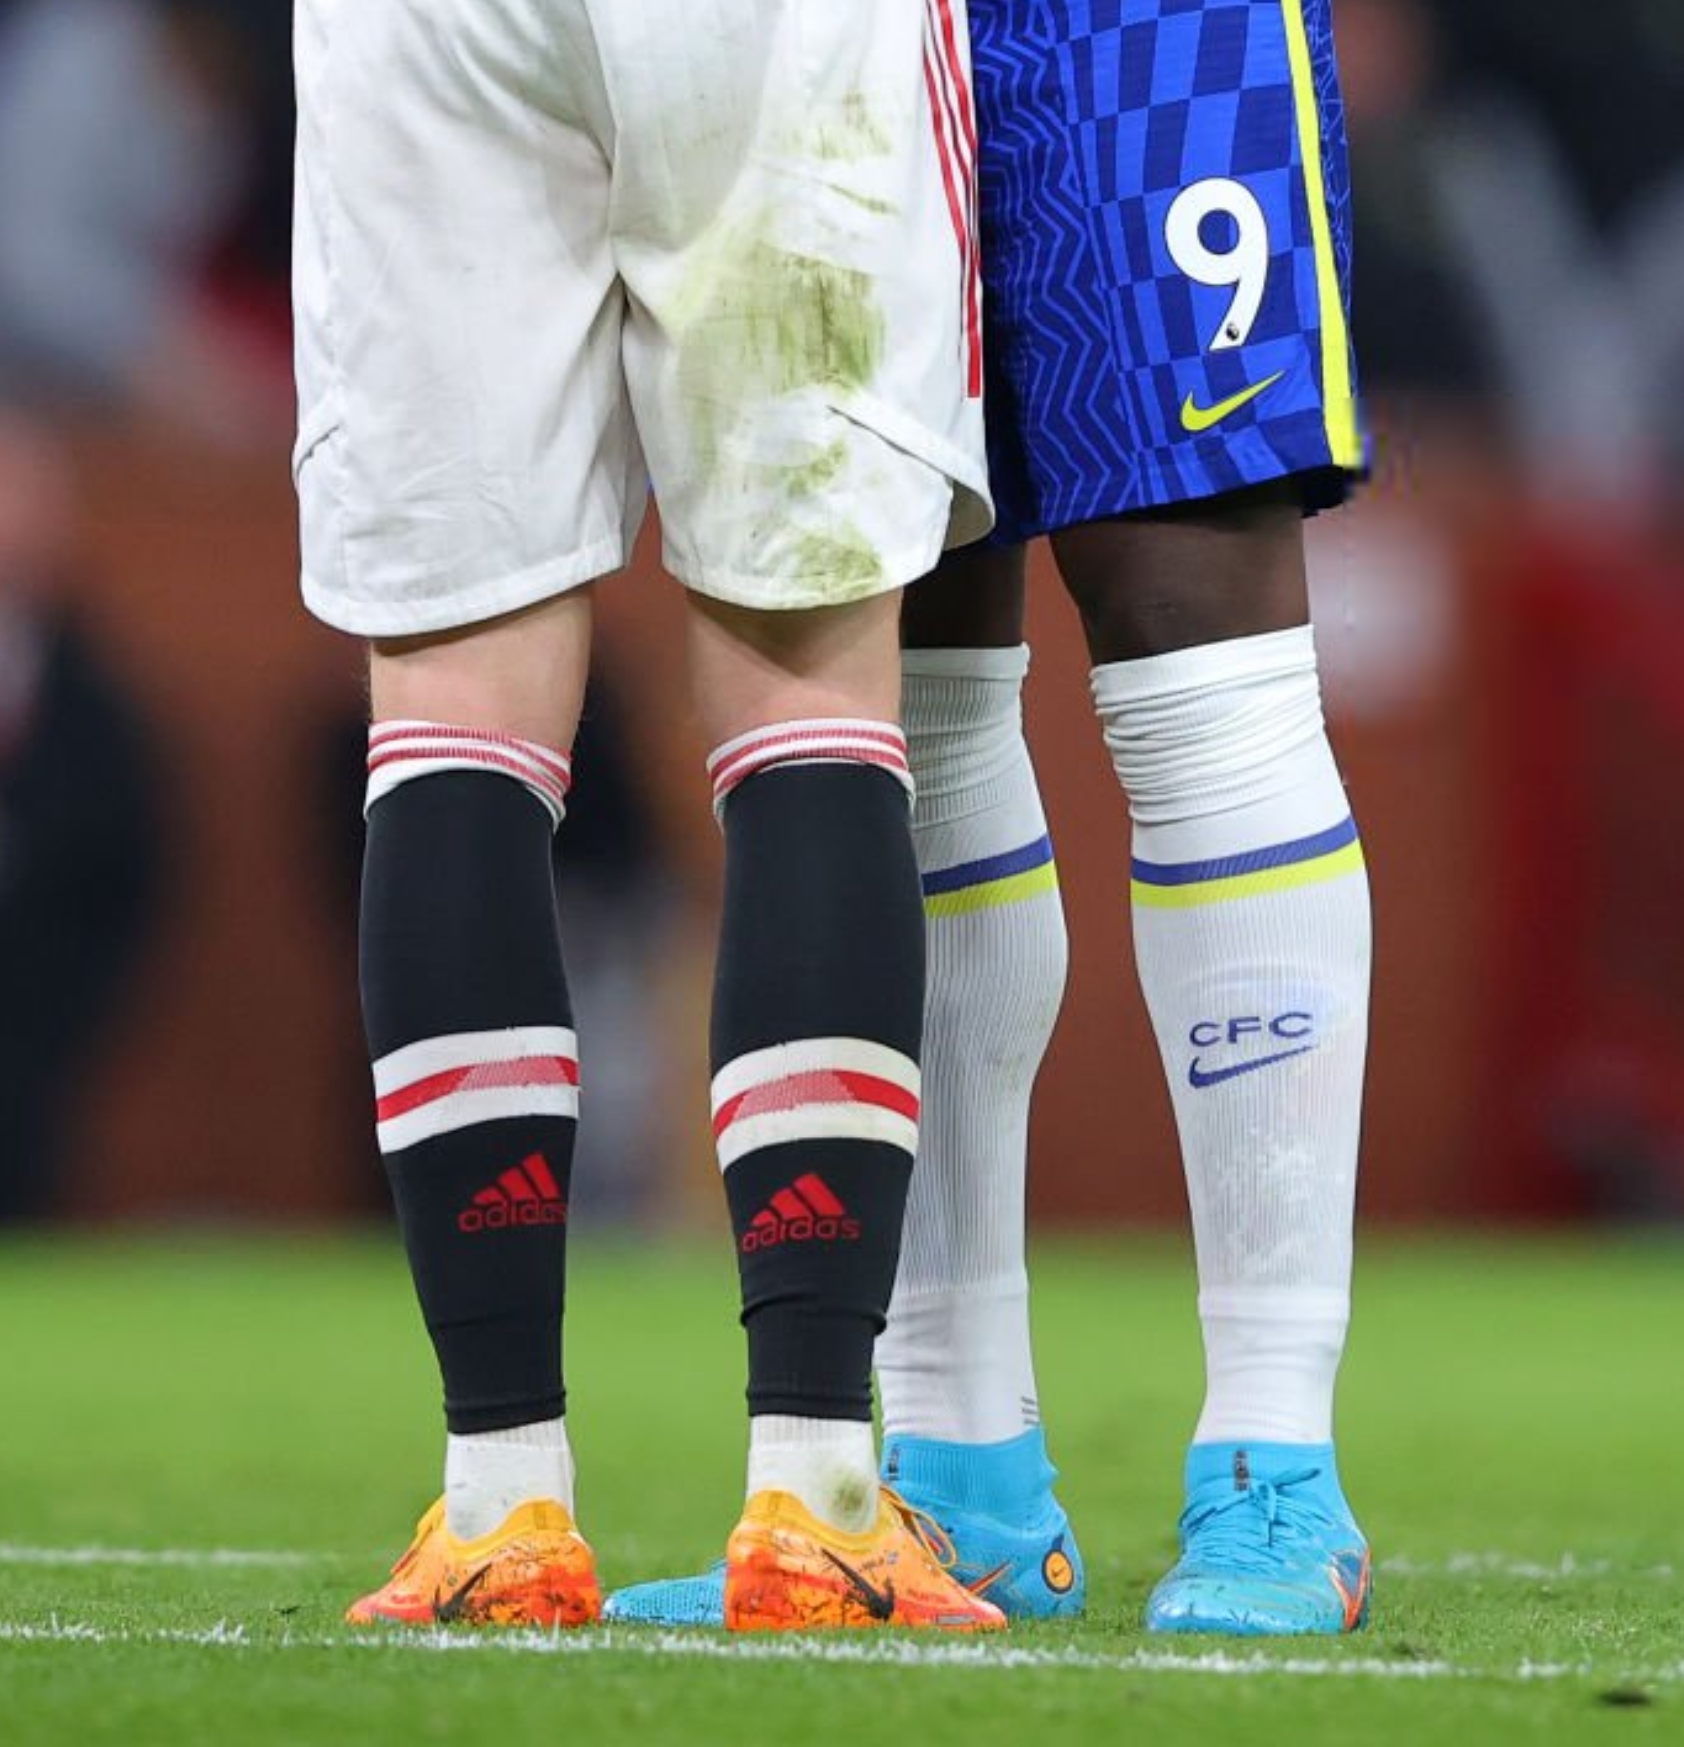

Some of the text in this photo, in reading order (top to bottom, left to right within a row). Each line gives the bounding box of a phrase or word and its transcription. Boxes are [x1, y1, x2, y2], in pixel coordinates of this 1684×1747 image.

[1164, 176, 1269, 351] 9
[1189, 1011, 1313, 1047] CFC
[742, 1213, 862, 1252] adidas
